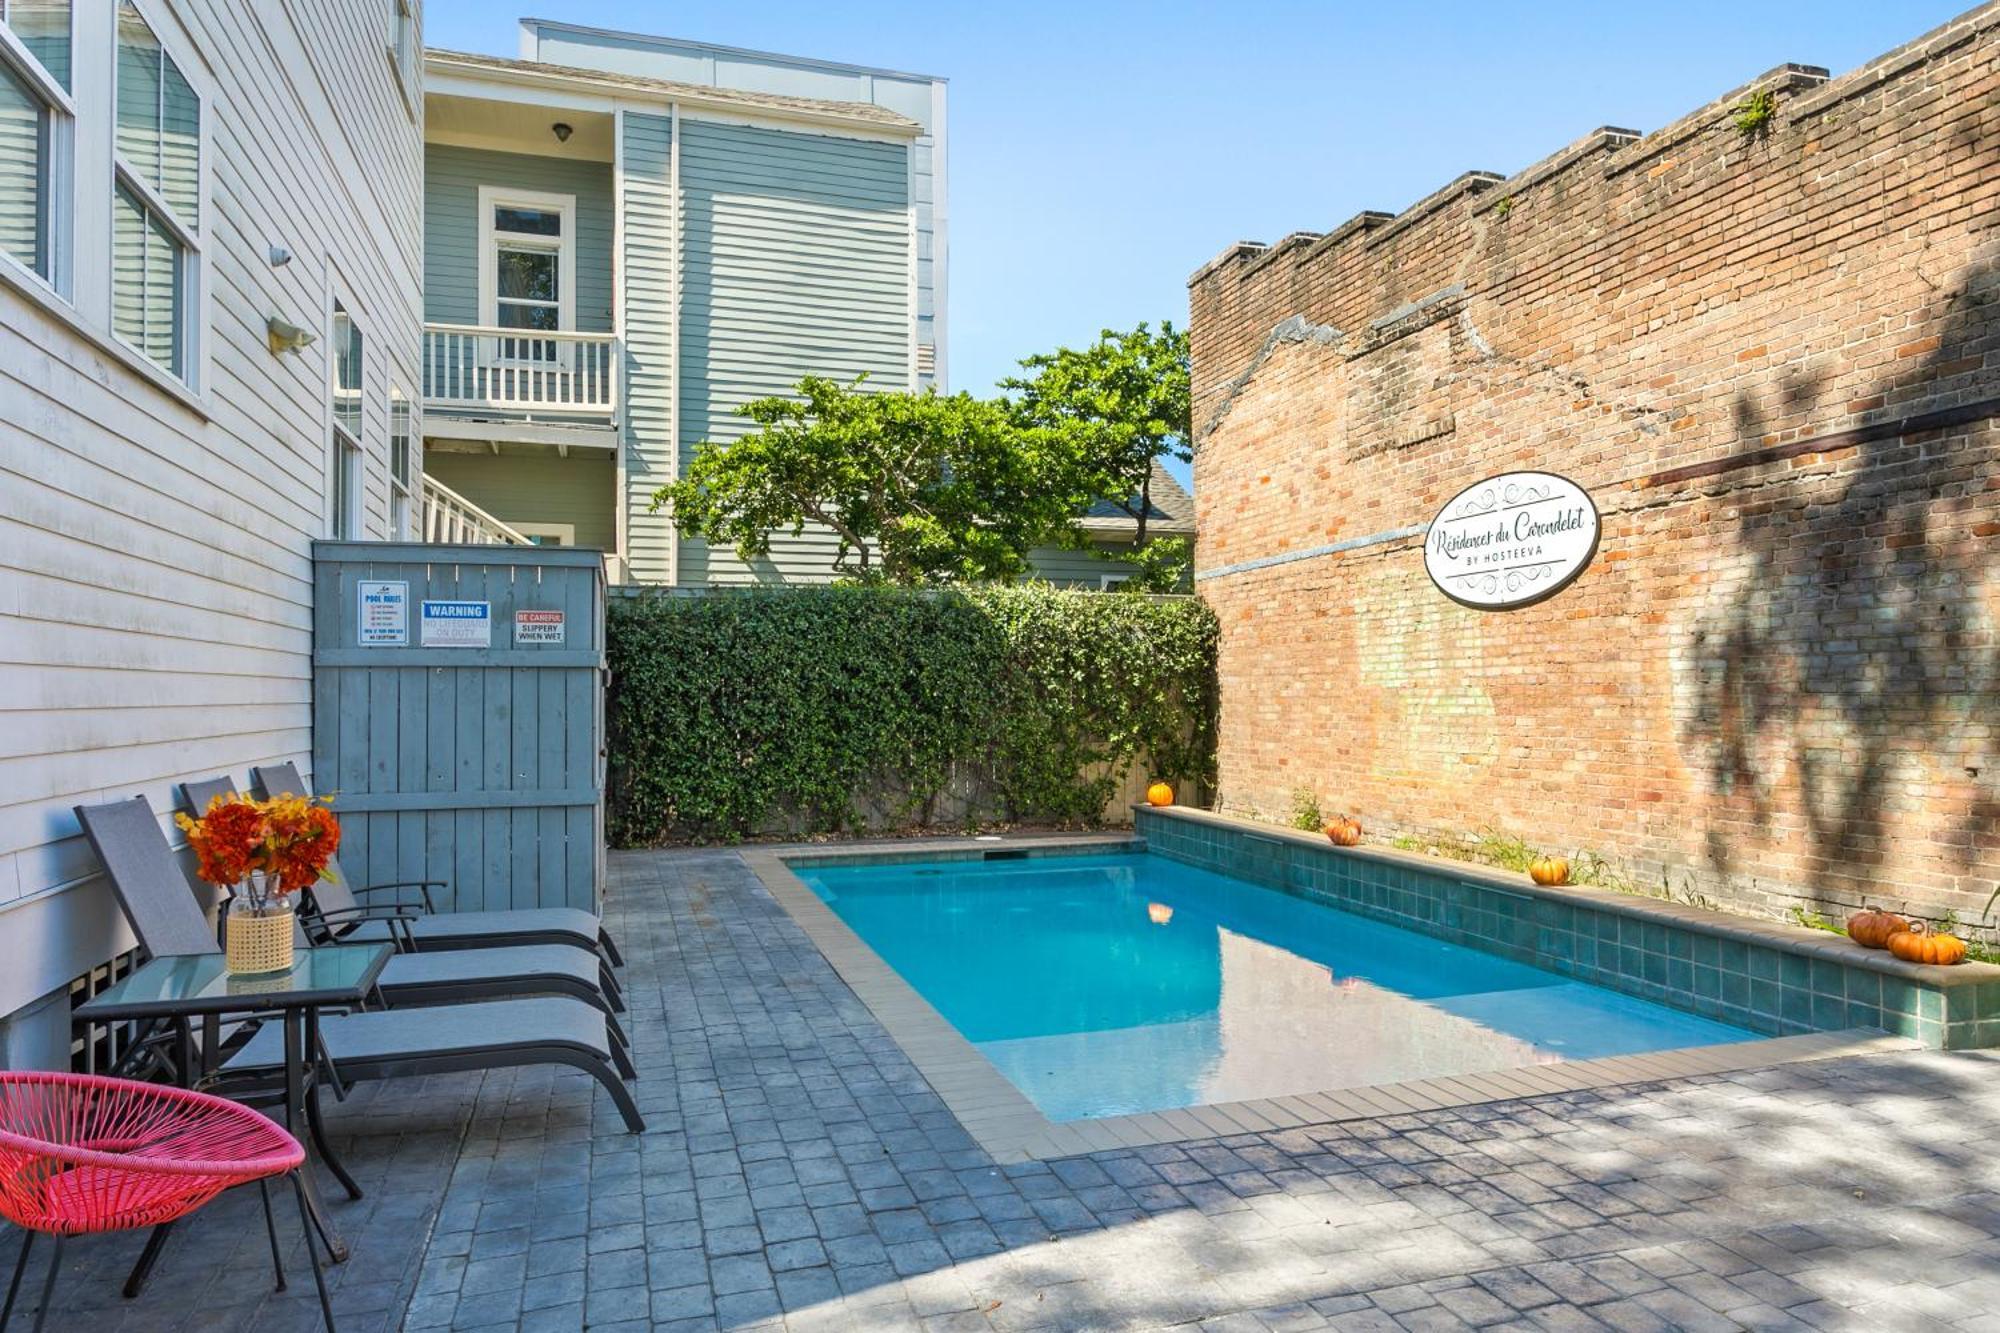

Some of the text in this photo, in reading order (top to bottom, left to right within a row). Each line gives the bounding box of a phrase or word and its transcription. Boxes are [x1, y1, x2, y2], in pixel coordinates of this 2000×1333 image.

[1495, 522, 1510, 543] du
[1514, 506, 1585, 542] Carondelet
[1466, 545, 1543, 566] BY HOSTEEVA
[429, 605, 482, 617] WARNING
[518, 613, 561, 622] BE CAREFUL
[424, 620, 488, 629] NO LIFEGUARD
[522, 624, 558, 632] SLIPPERY
[437, 629, 475, 637] ON DUTY
[518, 632, 561, 640] WHEN WET
